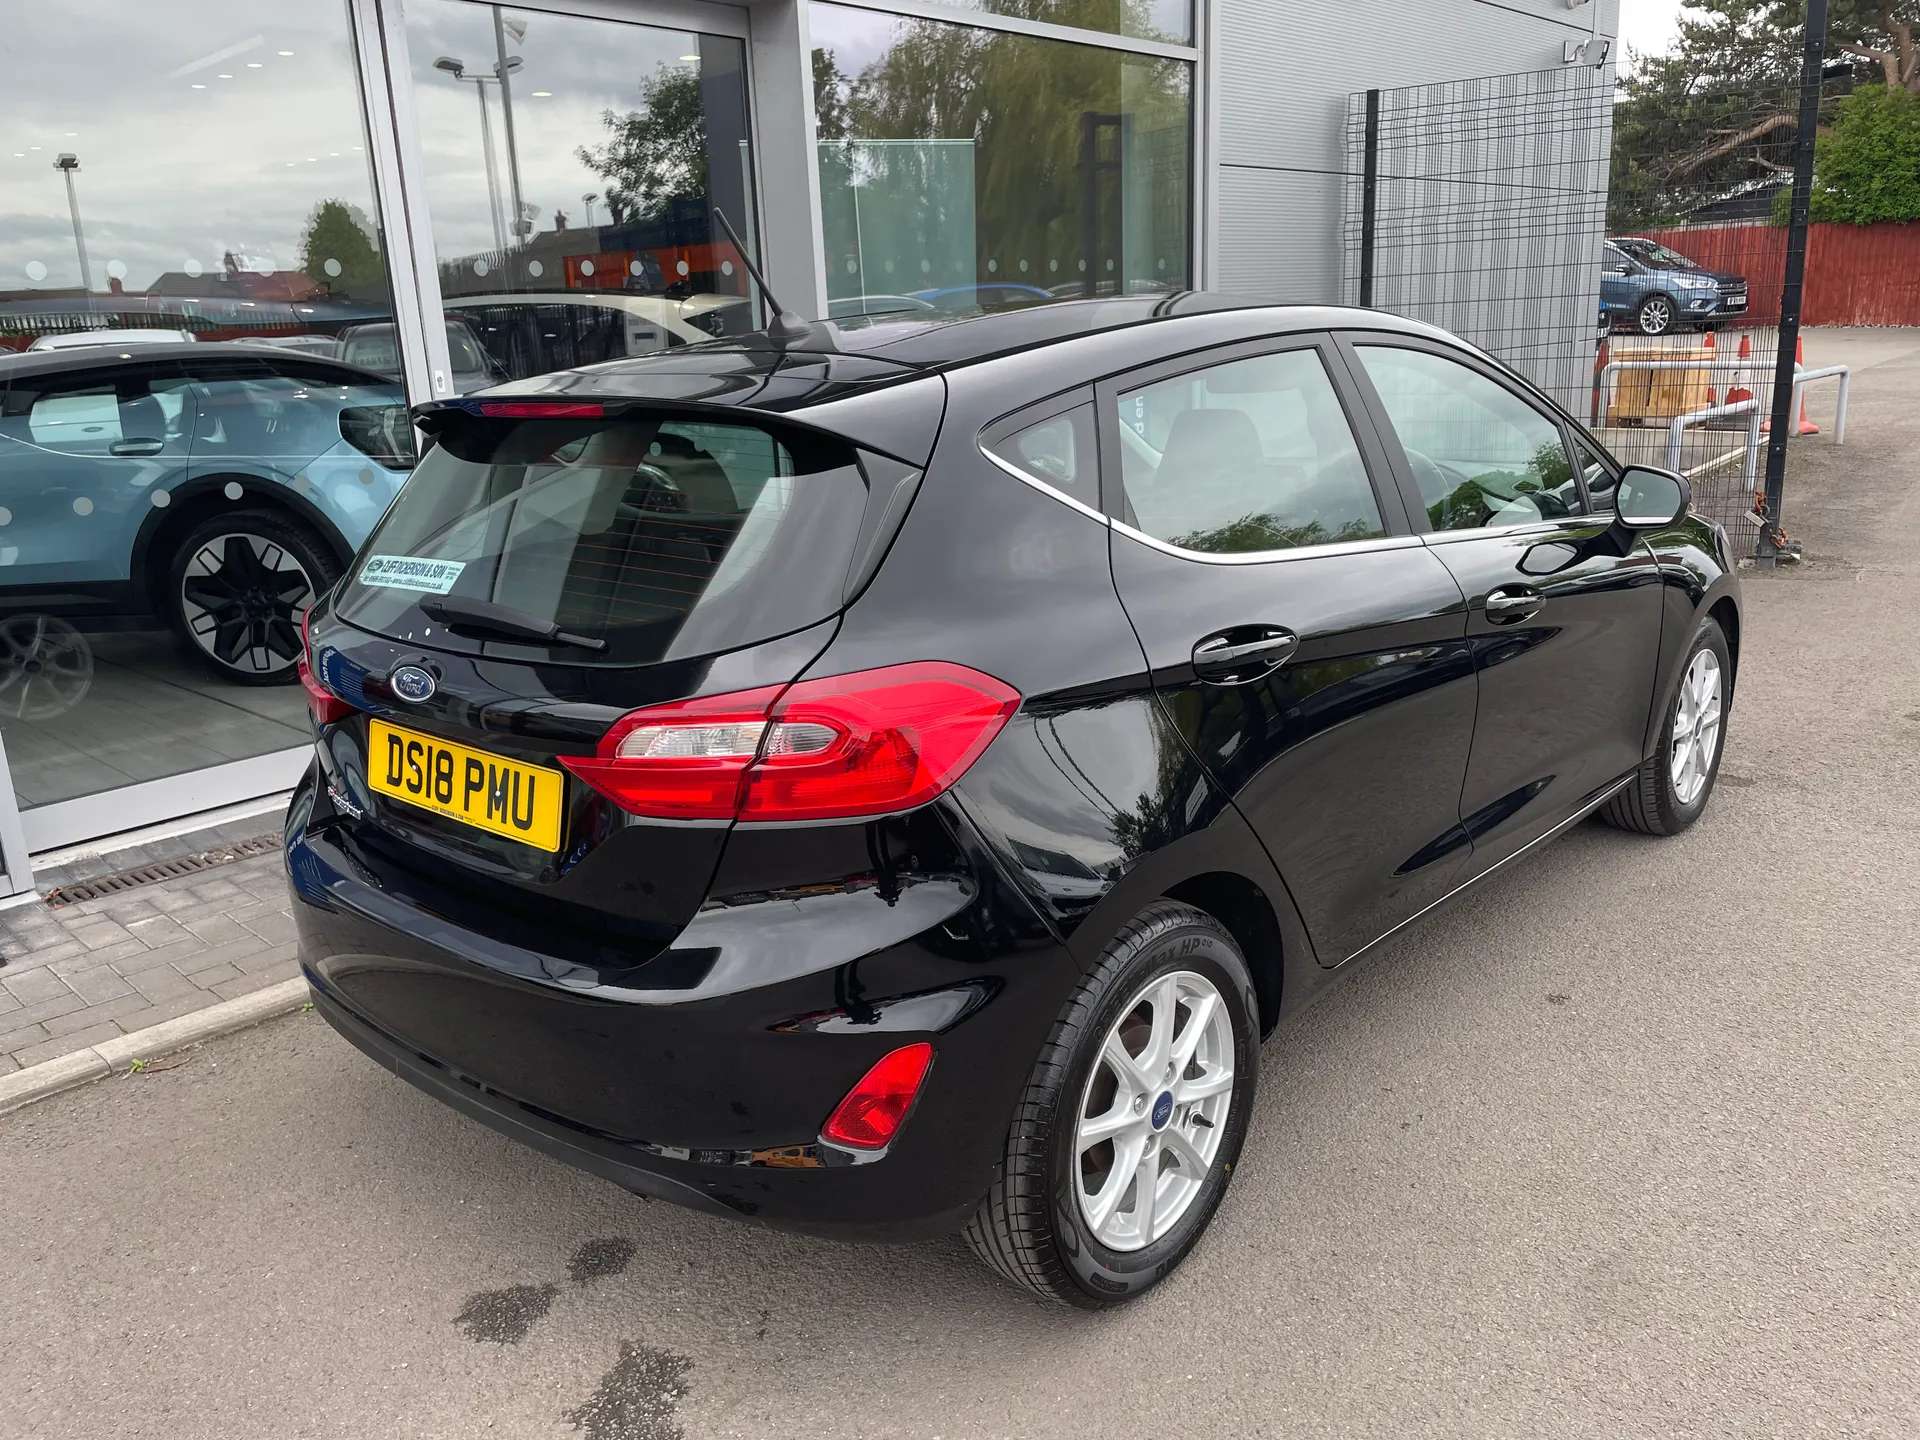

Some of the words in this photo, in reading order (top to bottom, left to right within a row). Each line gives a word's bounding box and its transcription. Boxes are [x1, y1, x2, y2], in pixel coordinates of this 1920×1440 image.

[400, 673, 424, 695] Ford
[386, 733, 454, 804] DS18
[465, 758, 535, 830] PMU
